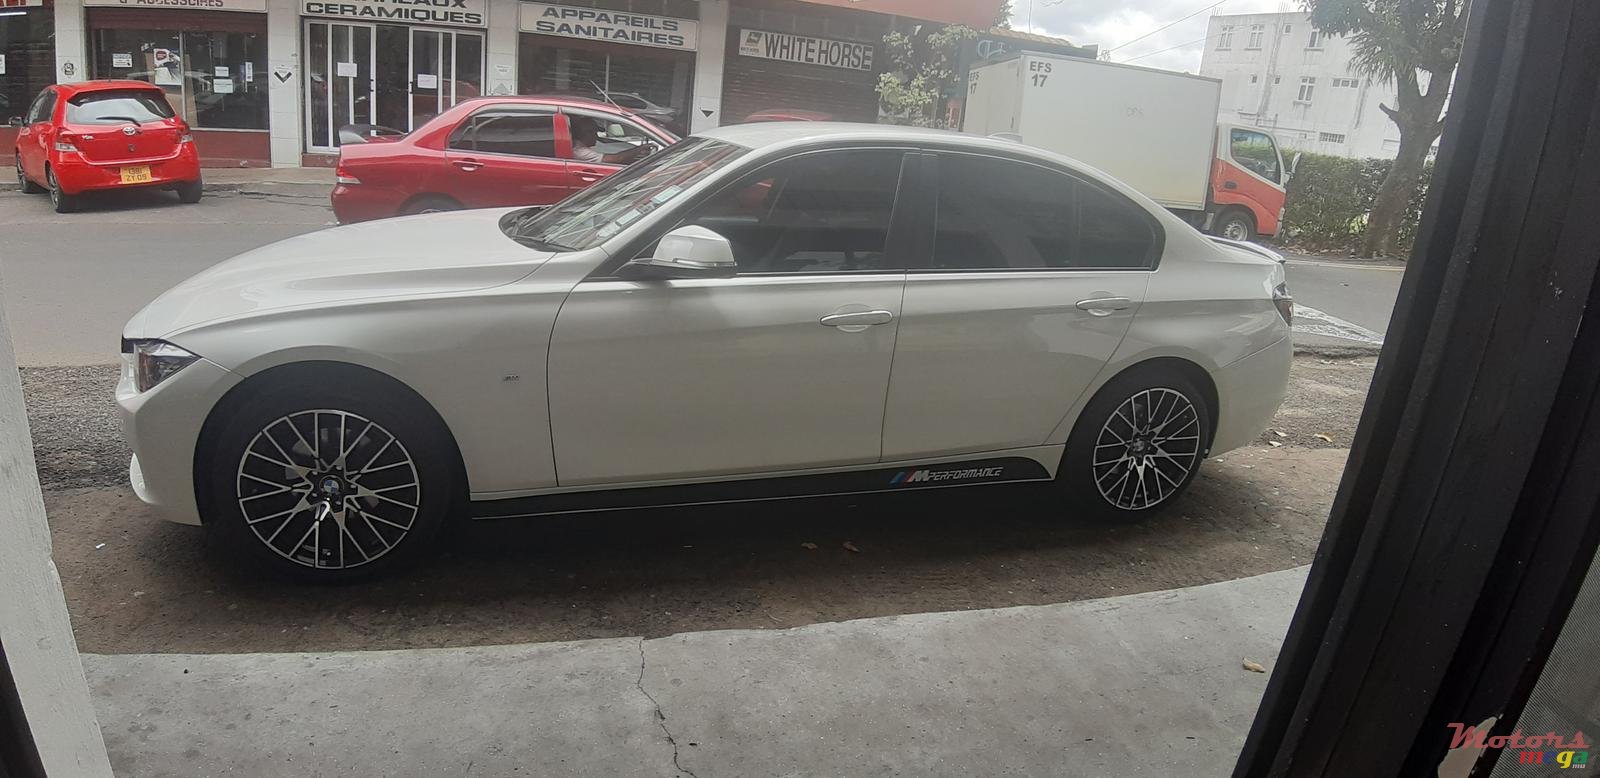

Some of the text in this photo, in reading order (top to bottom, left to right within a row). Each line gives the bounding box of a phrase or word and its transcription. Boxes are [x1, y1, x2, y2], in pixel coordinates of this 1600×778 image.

[306, 2, 482, 24] CERAMIQUES
[542, 7, 679, 31] APPAREILS
[536, 20, 685, 46] SANITAIRES
[765, 33, 873, 69] WHITE HORSE
[1029, 60, 1052, 73] EFS
[970, 83, 977, 95] 17
[1031, 74, 1048, 87] 17
